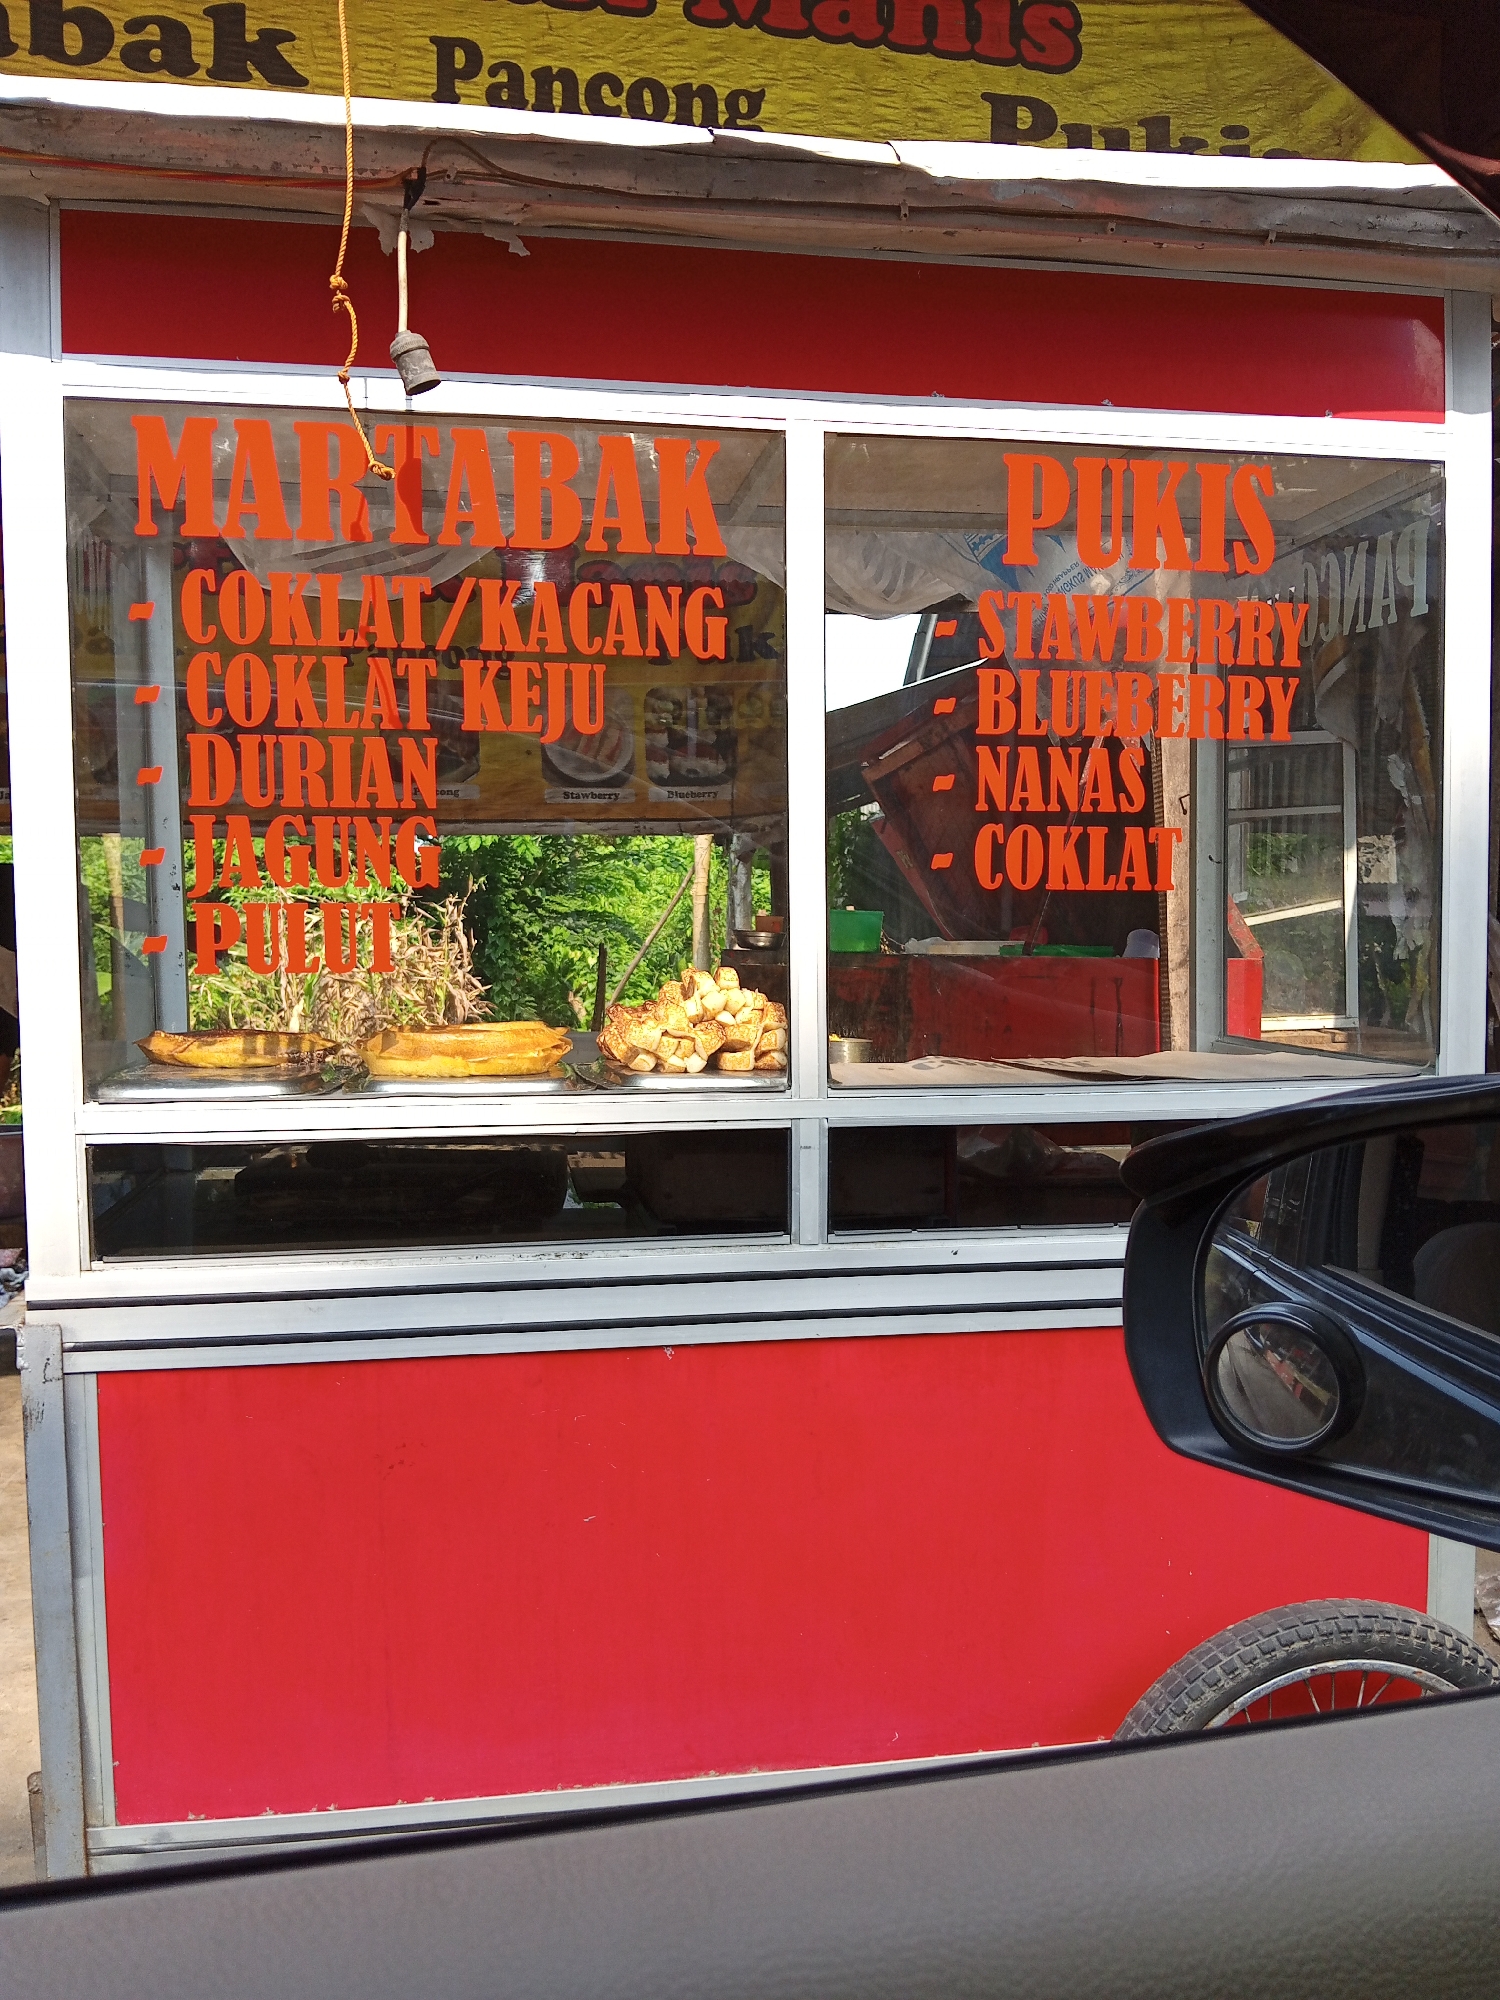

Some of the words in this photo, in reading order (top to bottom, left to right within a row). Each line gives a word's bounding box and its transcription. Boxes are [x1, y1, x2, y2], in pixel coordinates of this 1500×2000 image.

[0, 0, 310, 87] bak
[429, 35, 765, 132] Pancong
[981, 92, 1301, 159] Puk
[131, 415, 727, 557] MARTABAK
[1003, 453, 1275, 575] PUKIS
[181, 569, 728, 660] COKLAT/KACANG
[978, 590, 1310, 667] STAWBERRY
[186, 651, 438, 731] COKLAT
[459, 659, 608, 744] KEJU
[976, 668, 1300, 741] BLUEBERRY
[186, 733, 438, 809] DURIAN
[562, 790, 621, 801] Stawberry
[975, 745, 1146, 813] NANAS
[187, 815, 441, 898] JAGUNG
[974, 823, 1183, 891] COKLAT
[192, 902, 402, 976] PULUT
